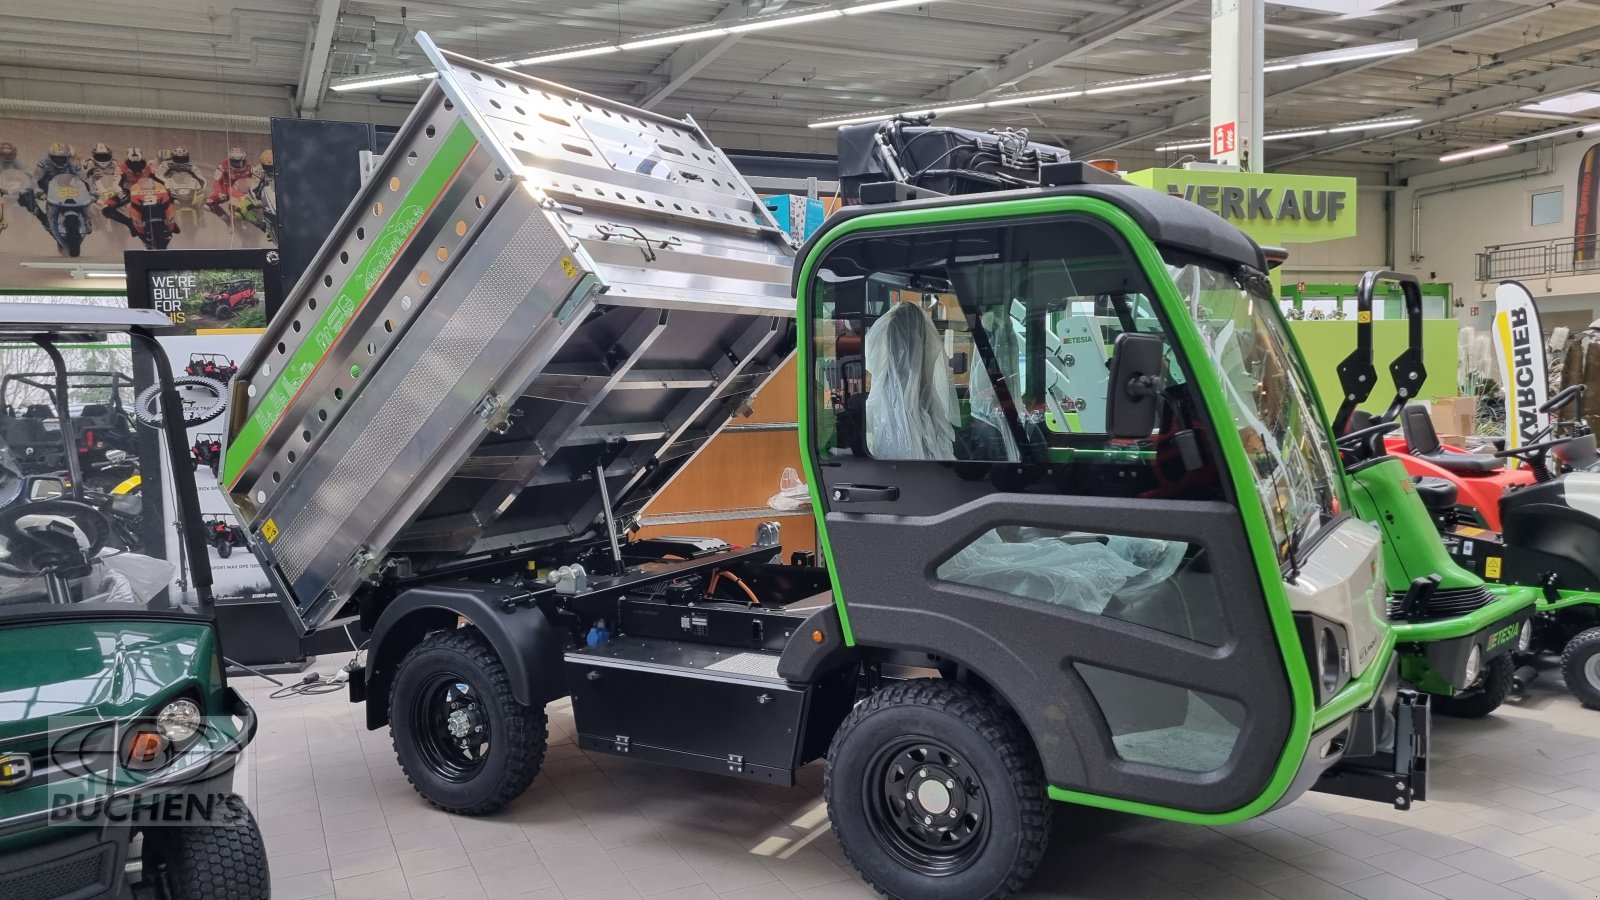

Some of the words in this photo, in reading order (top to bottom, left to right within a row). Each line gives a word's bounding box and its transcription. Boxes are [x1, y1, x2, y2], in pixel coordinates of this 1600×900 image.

[152, 275, 196, 288] WE'RE
[153, 288, 190, 300] BUILT
[155, 300, 182, 312] FOR
[168, 312, 186, 324] IS
[1064, 336, 1093, 344] ETESIA
[1487, 621, 1519, 651] ETESIA
